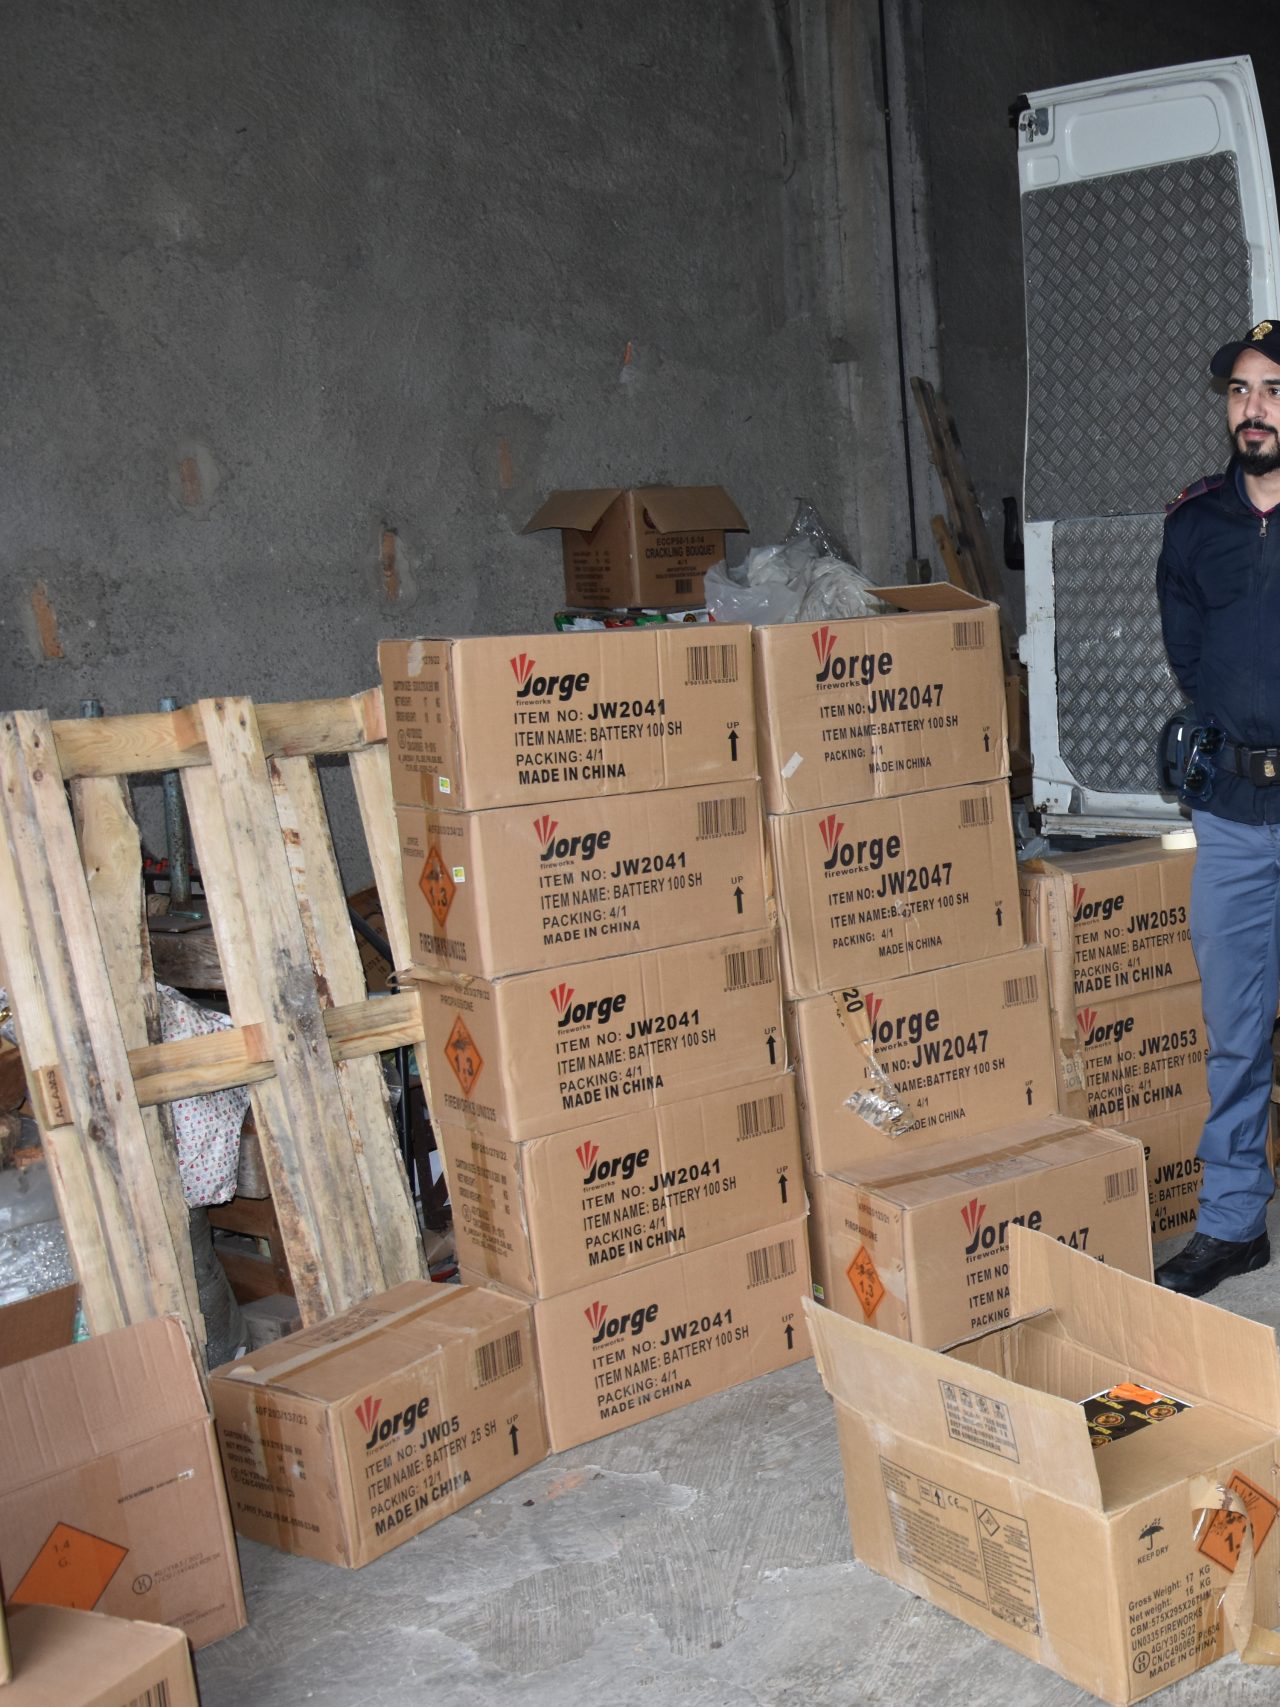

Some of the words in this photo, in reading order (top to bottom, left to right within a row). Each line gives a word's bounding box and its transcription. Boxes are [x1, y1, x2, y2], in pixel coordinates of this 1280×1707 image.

[816, 652, 893, 685] Jorge
[517, 673, 590, 701] Jorge
[816, 680, 860, 691] fireworks
[820, 705, 845, 719] ITEM
[848, 704, 865, 715] NO:
[868, 684, 944, 714] JW2047
[514, 712, 549, 724] ITEM
[557, 710, 583, 722] NO:
[588, 699, 666, 720] JW2041
[726, 721, 739, 729] UP
[515, 731, 544, 747] ITEM
[548, 729, 587, 745] NAME:
[590, 724, 643, 742] BATTERY
[647, 722, 664, 737] 100
[667, 721, 682, 735] SH
[516, 751, 582, 766] PACKING:
[586, 749, 603, 762] 4/1
[824, 748, 865, 762] PACKING:
[869, 760, 895, 774] MADE
[896, 759, 905, 771] IN
[907, 757, 931, 769] CHINA
[519, 768, 559, 785] MADE
[564, 767, 578, 781] IN
[582, 764, 626, 780] CHINA
[540, 829, 611, 861] Jorge
[824, 836, 900, 870] Jorge
[610, 851, 686, 879] JW2041
[877, 863, 952, 897] JW2047
[1073, 895, 1124, 922] Jorge
[1105, 928, 1124, 939] NO:
[1127, 907, 1186, 934] JW2053
[1074, 962, 1122, 979] PACKING:
[1075, 975, 1111, 994] MADE
[1116, 972, 1128, 986] IN
[1133, 963, 1172, 982] CHINA
[557, 992, 626, 1027] Jorge
[626, 1009, 701, 1040] JW2041
[1085, 1017, 1134, 1047] Jorge
[1139, 1029, 1197, 1058] JW2053
[893, 1059, 910, 1072] NO:
[913, 1030, 988, 1068] JW2047
[583, 1148, 650, 1185] Jorge
[650, 1158, 721, 1193] JW2041
[592, 1303, 659, 1344] Jorge
[592, 1349, 626, 1370] ITEM
[632, 1340, 656, 1356] NO:
[660, 1309, 733, 1347] JW2041
[366, 1397, 429, 1449] Jorge
[507, 1414, 518, 1425] UP
[365, 1456, 392, 1478] ITEM
[397, 1444, 416, 1459] NO:
[420, 1416, 459, 1449] JW05
[368, 1477, 394, 1500] ITEM
[394, 1462, 424, 1487] NAME:
[426, 1436, 467, 1468] BATTERY
[471, 1428, 482, 1444] 25
[485, 1420, 497, 1437] SH
[370, 1485, 418, 1519] PACKING:
[423, 1471, 442, 1488] 12/1
[375, 1504, 413, 1536] MADE
[415, 1495, 428, 1511] IN
[1138, 1552, 1155, 1565] KEEP
[1155, 1545, 1168, 1557] DRY
[1129, 1594, 1152, 1612] Gross
[1153, 1579, 1182, 1600] Weight:
[1186, 1572, 1193, 1585] 17
[1200, 1565, 1210, 1576] KG
[1129, 1611, 1143, 1625] Net
[1145, 1598, 1172, 1618] weight:
[1186, 1586, 1193, 1597] 16
[1201, 1577, 1211, 1588] KG
[1132, 1630, 1159, 1651] UN0335
[1160, 1606, 1203, 1637] FIREWORKS
[1150, 1660, 1175, 1679] MADE
[1178, 1652, 1187, 1663] IN
[1189, 1637, 1217, 1656] CHINA
